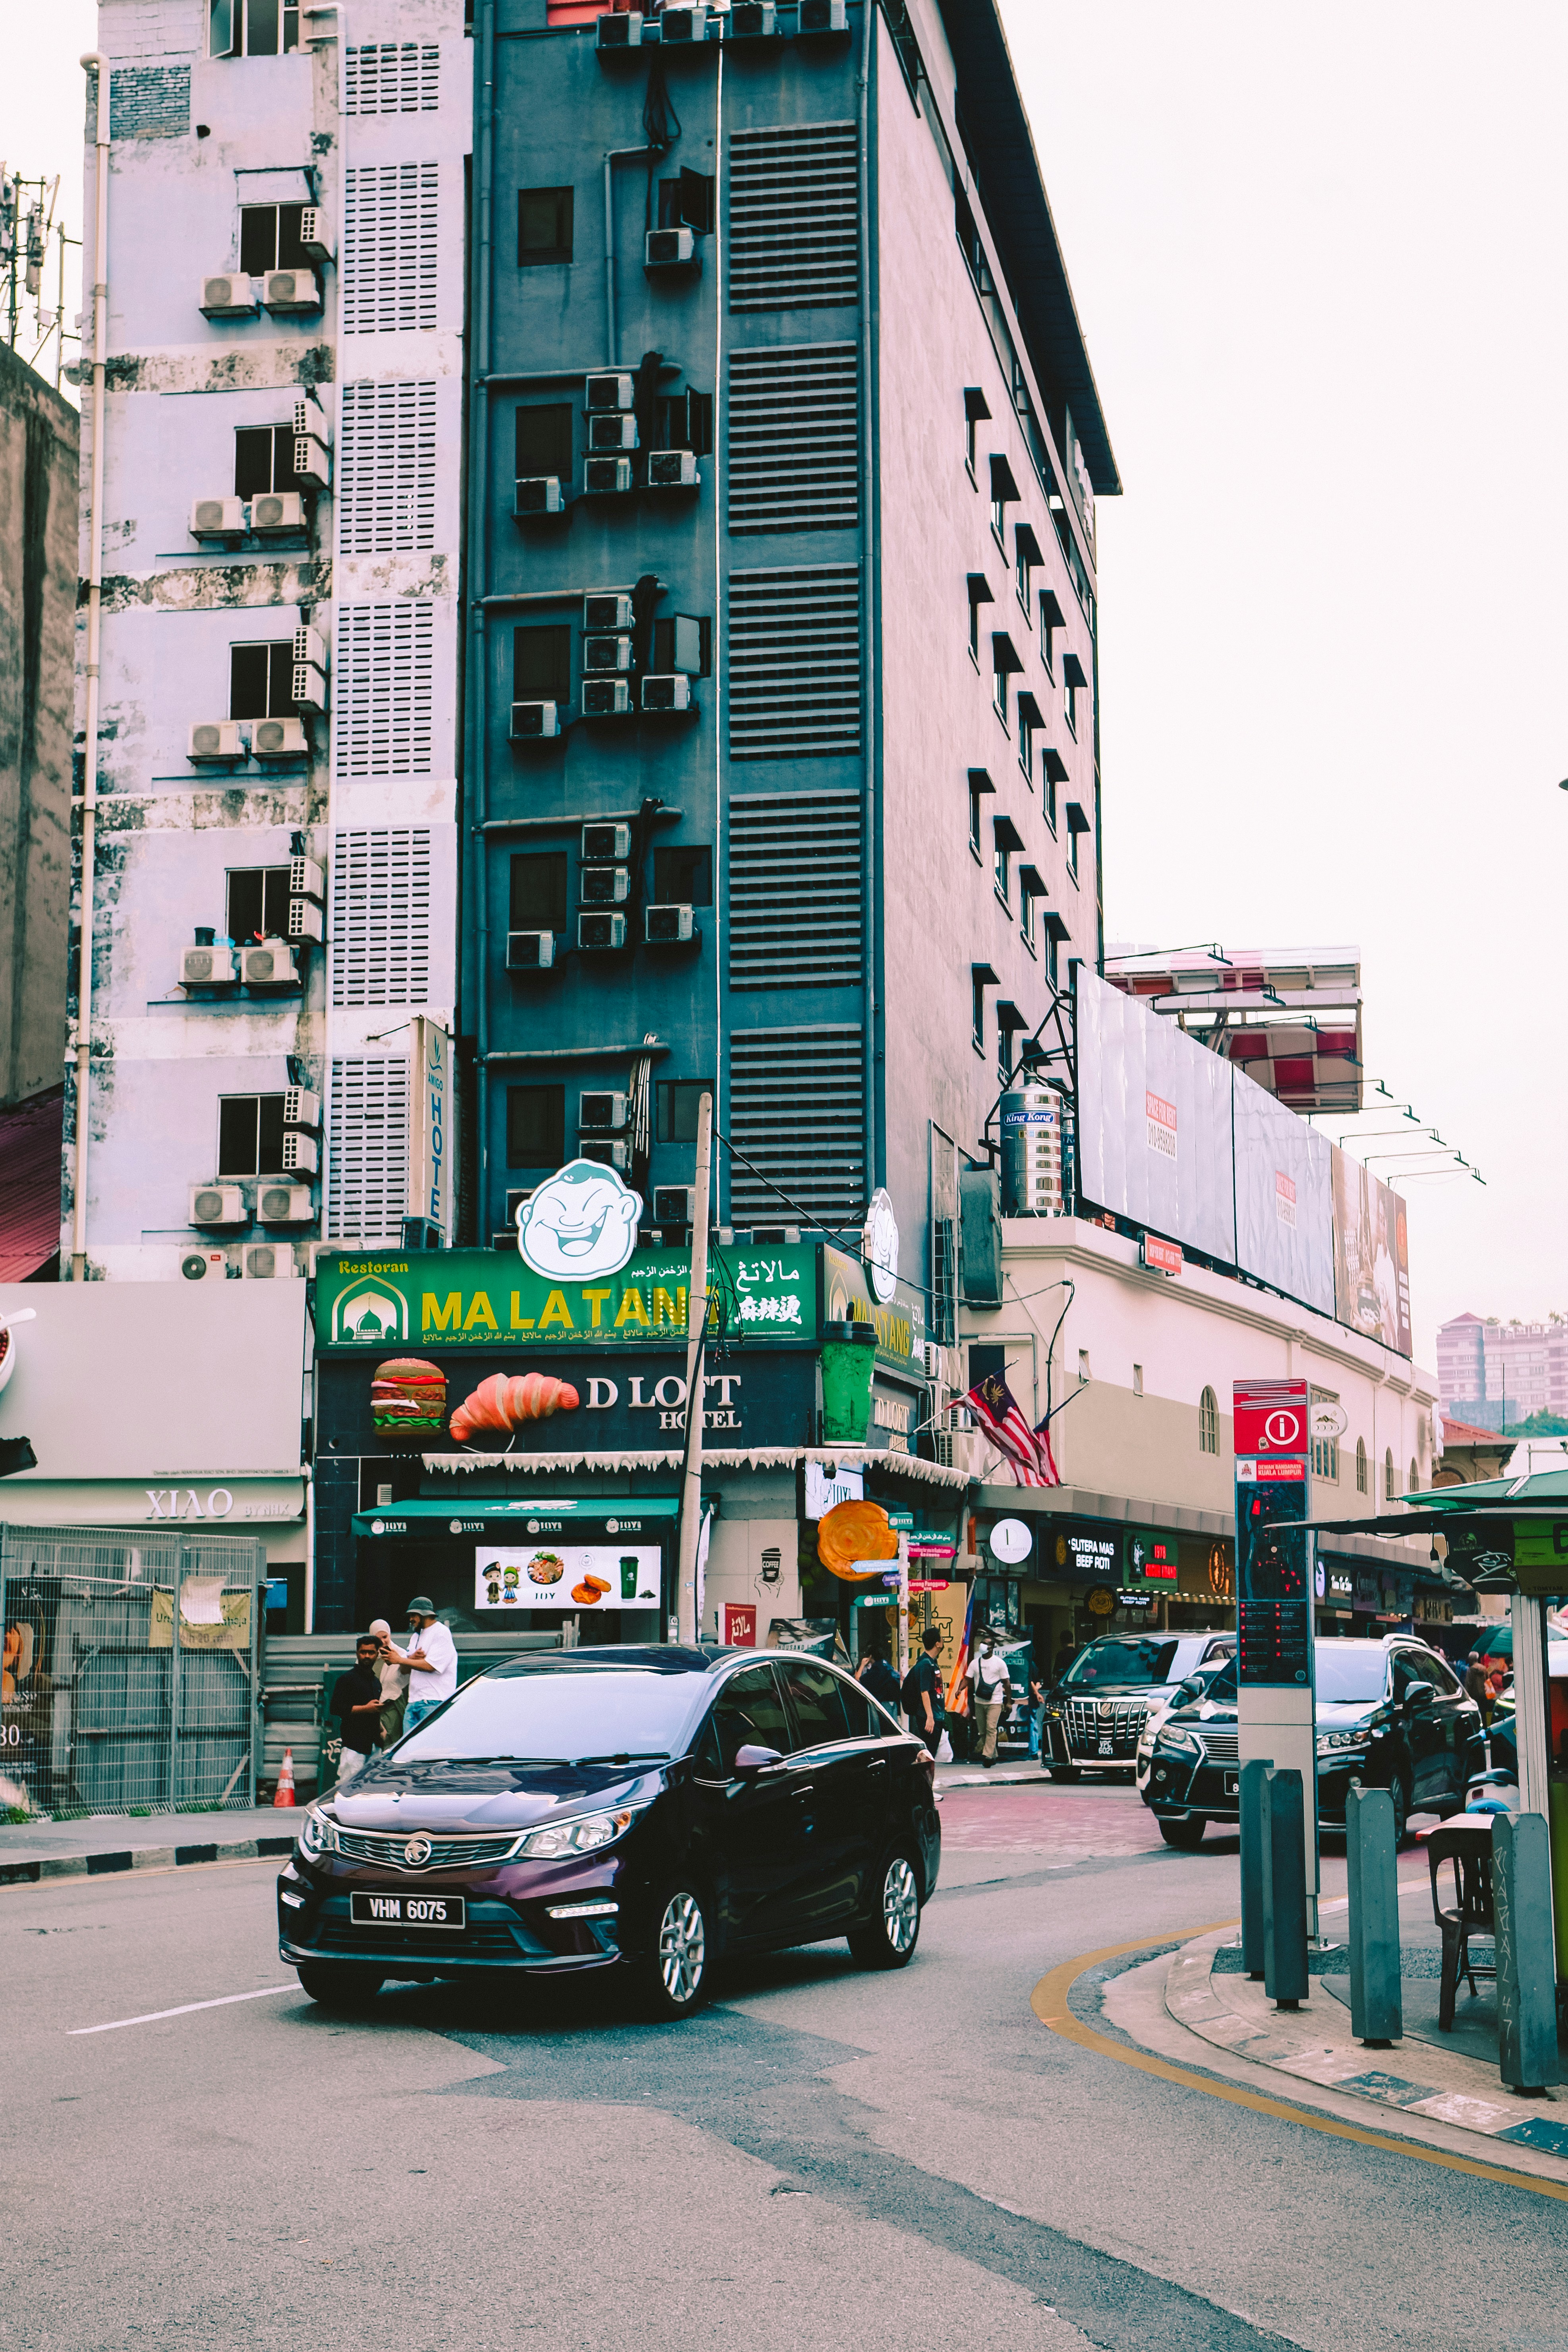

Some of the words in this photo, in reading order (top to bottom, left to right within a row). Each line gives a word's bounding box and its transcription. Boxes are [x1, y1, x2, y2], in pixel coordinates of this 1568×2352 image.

[428, 1072, 443, 1092] AMIGO
[1006, 1114, 1025, 1123] King
[1027, 1112, 1052, 1122] Kong
[430, 1093, 443, 1219] HOTE
[339, 1261, 408, 1274] Restoran
[586, 1377, 619, 1408] D
[146, 1488, 234, 1519] XIAO
[1071, 1538, 1098, 1553] SUTERA
[1099, 1542, 1114, 1555] MAS
[1076, 1554, 1093, 1568] BEEF
[1094, 1556, 1110, 1570] ROTI
[369, 1898, 400, 1918] VHM
[407, 1900, 447, 1921] 6075
